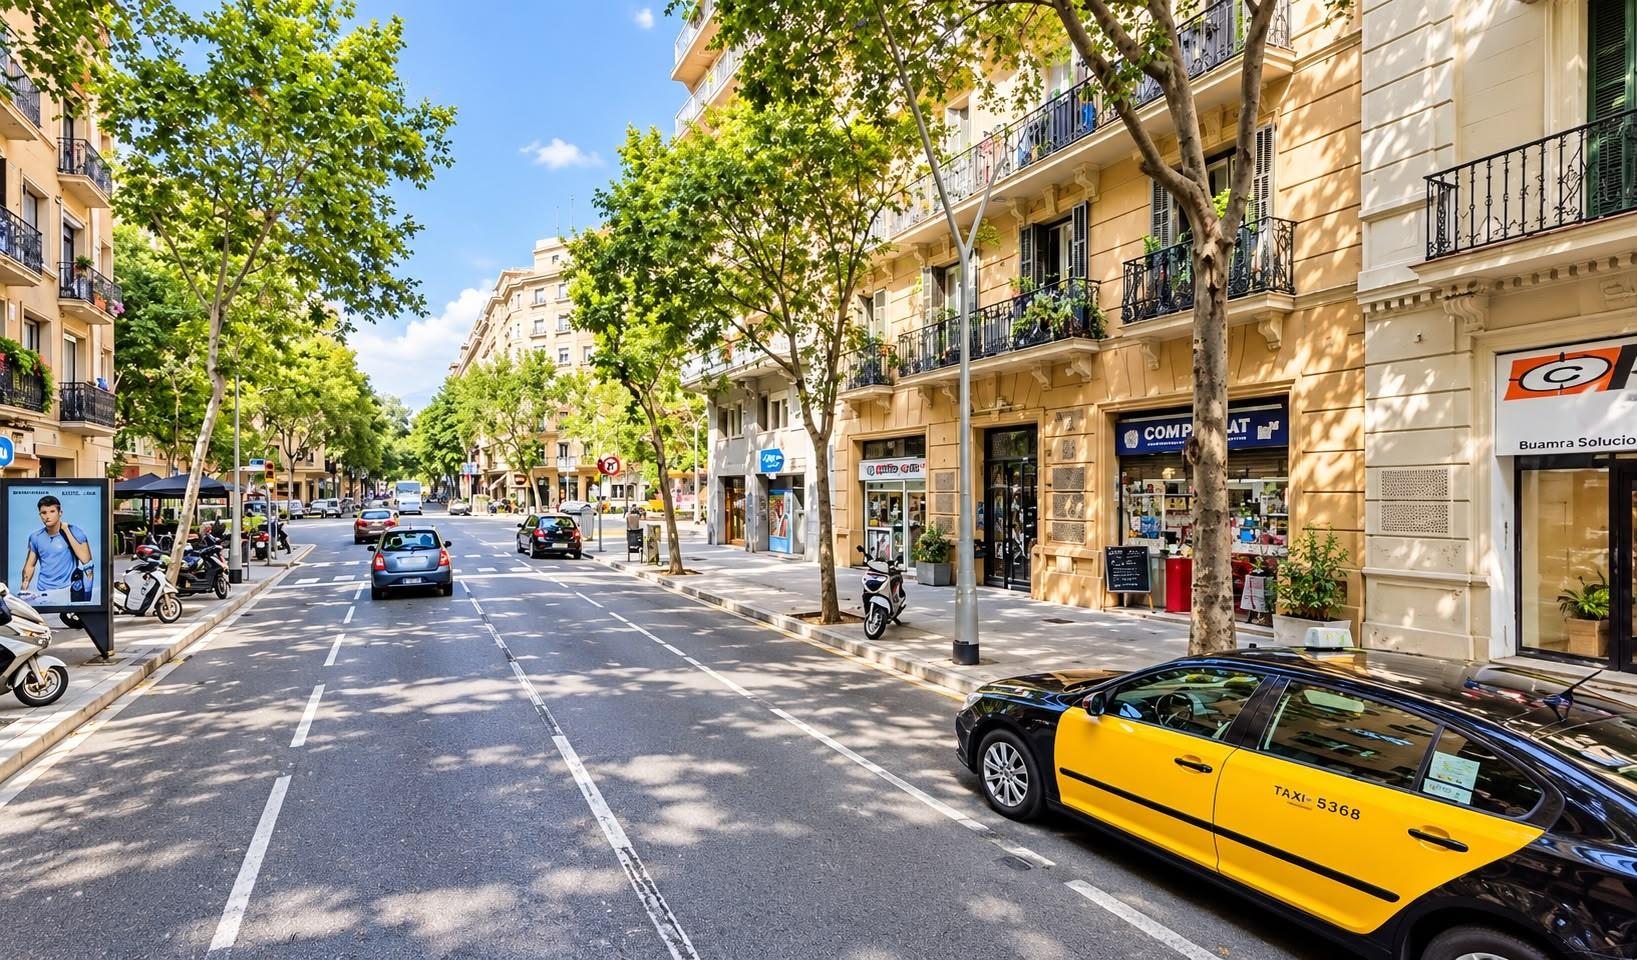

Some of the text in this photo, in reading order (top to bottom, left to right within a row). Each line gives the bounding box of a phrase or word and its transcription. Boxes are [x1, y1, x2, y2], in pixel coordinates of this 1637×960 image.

[1144, 418, 1251, 441] COMPAT
[1519, 439, 1574, 450] Buamra
[1274, 785, 1305, 803] TAXI
[1316, 797, 1361, 821] 5368
